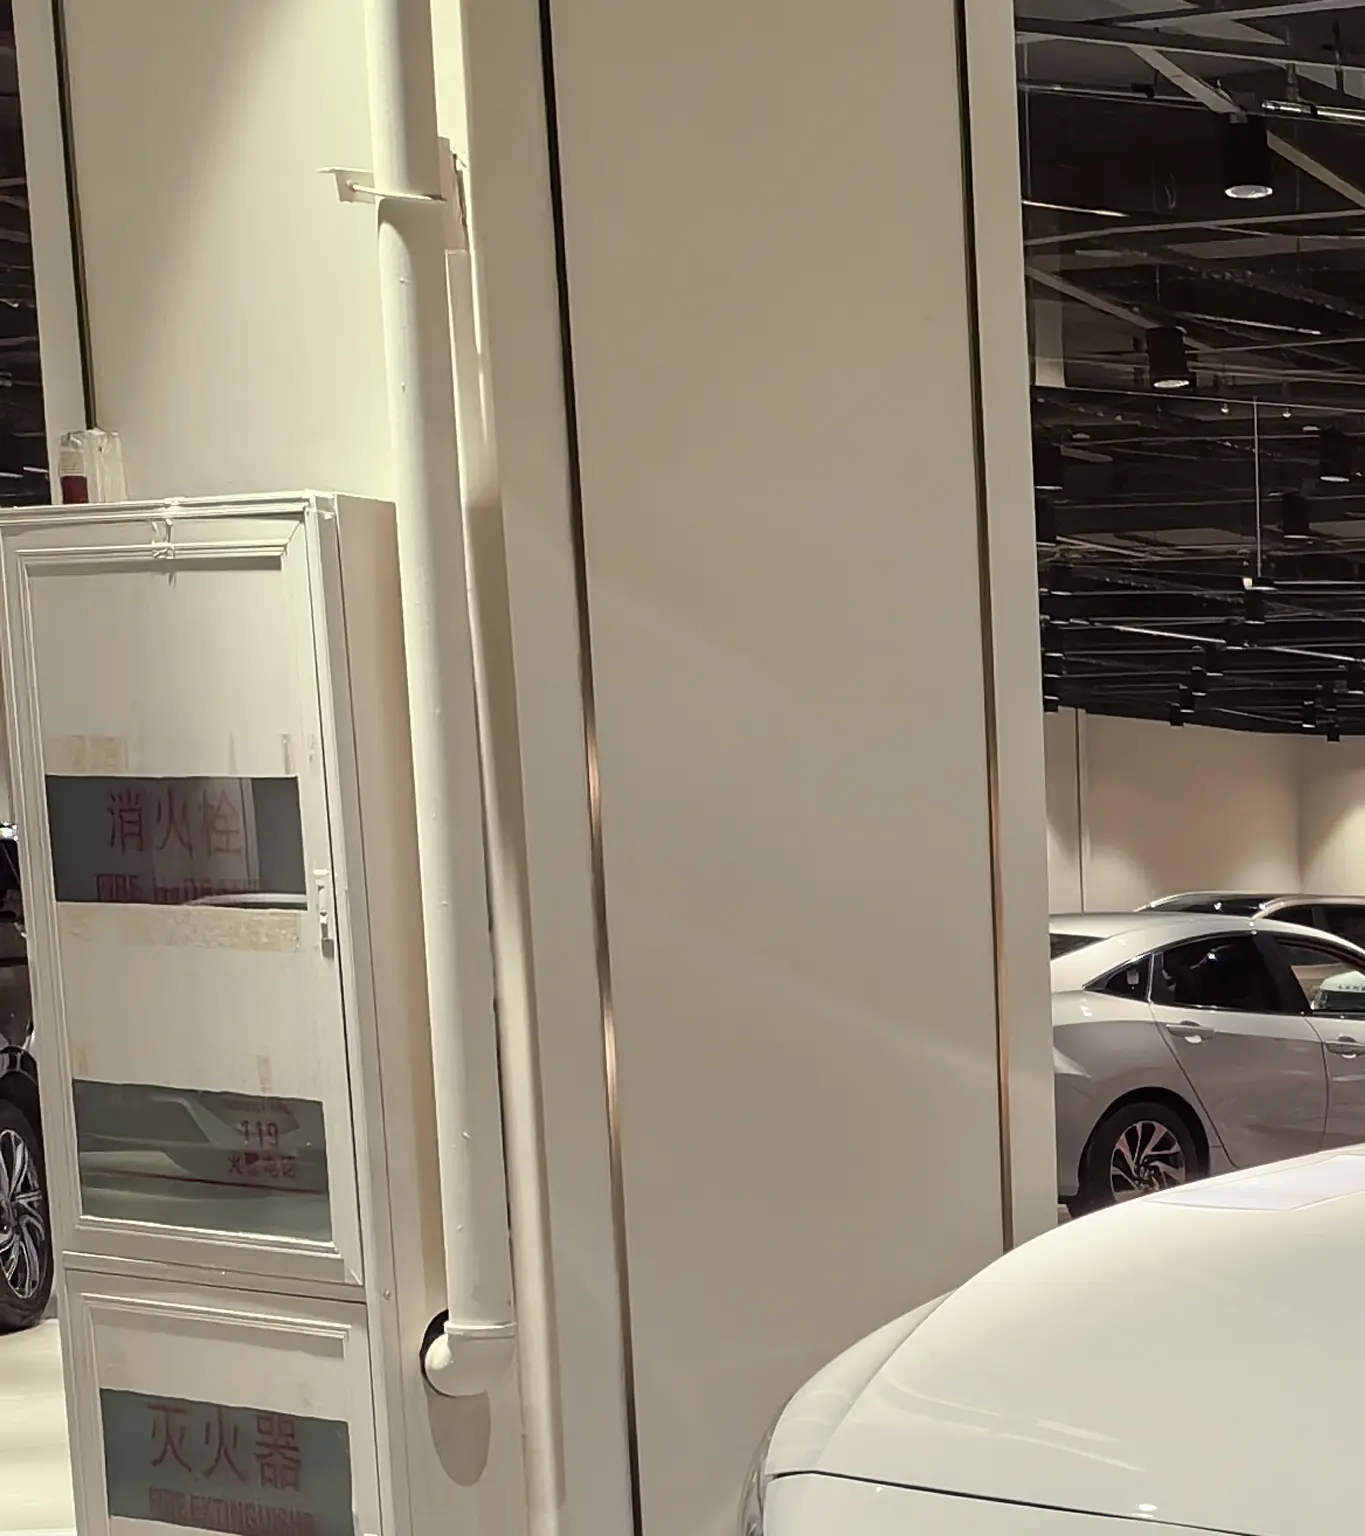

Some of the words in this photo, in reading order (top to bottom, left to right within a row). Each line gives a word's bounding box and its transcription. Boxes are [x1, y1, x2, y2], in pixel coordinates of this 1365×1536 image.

[107, 787, 242, 857] 消火栓
[240, 1120, 280, 1148] 119
[147, 1401, 302, 1491] 灭火器
